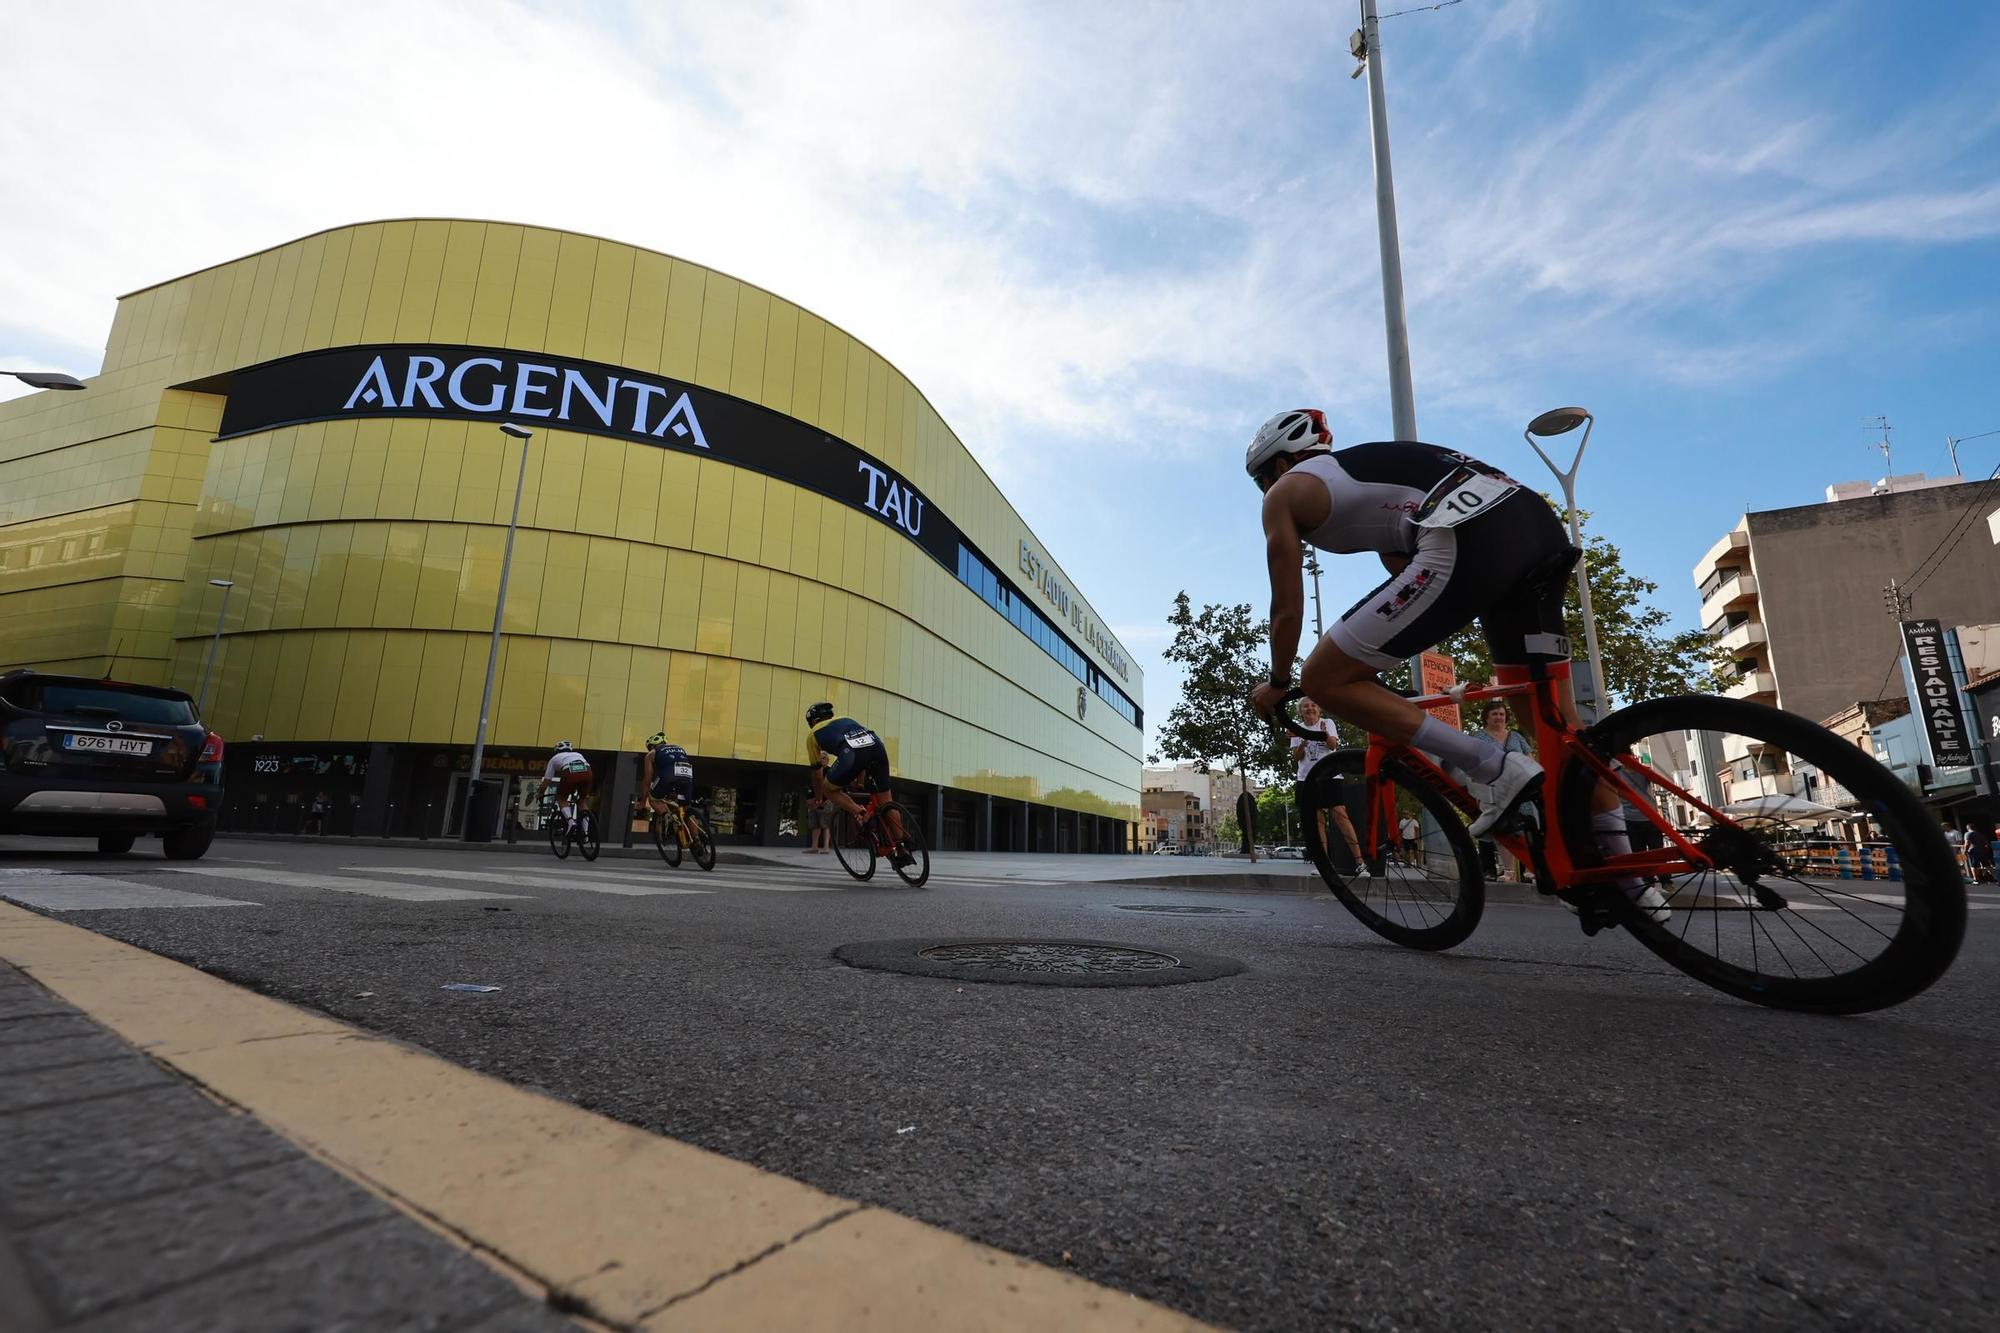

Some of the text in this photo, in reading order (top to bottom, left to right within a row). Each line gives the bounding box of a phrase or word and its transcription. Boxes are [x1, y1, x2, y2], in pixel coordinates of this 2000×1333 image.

[342, 355, 710, 448] ARGENTA
[858, 460, 924, 536] TAU
[1446, 490, 1483, 514] 10
[1019, 538, 1070, 617] ESTADIO
[1908, 627, 1937, 638] AMBAR
[1556, 637, 1569, 654] 10
[1915, 636, 1960, 750] RESTAURANTE
[77, 736, 148, 753] 6761 HVT
[254, 760, 280, 773] 1923
